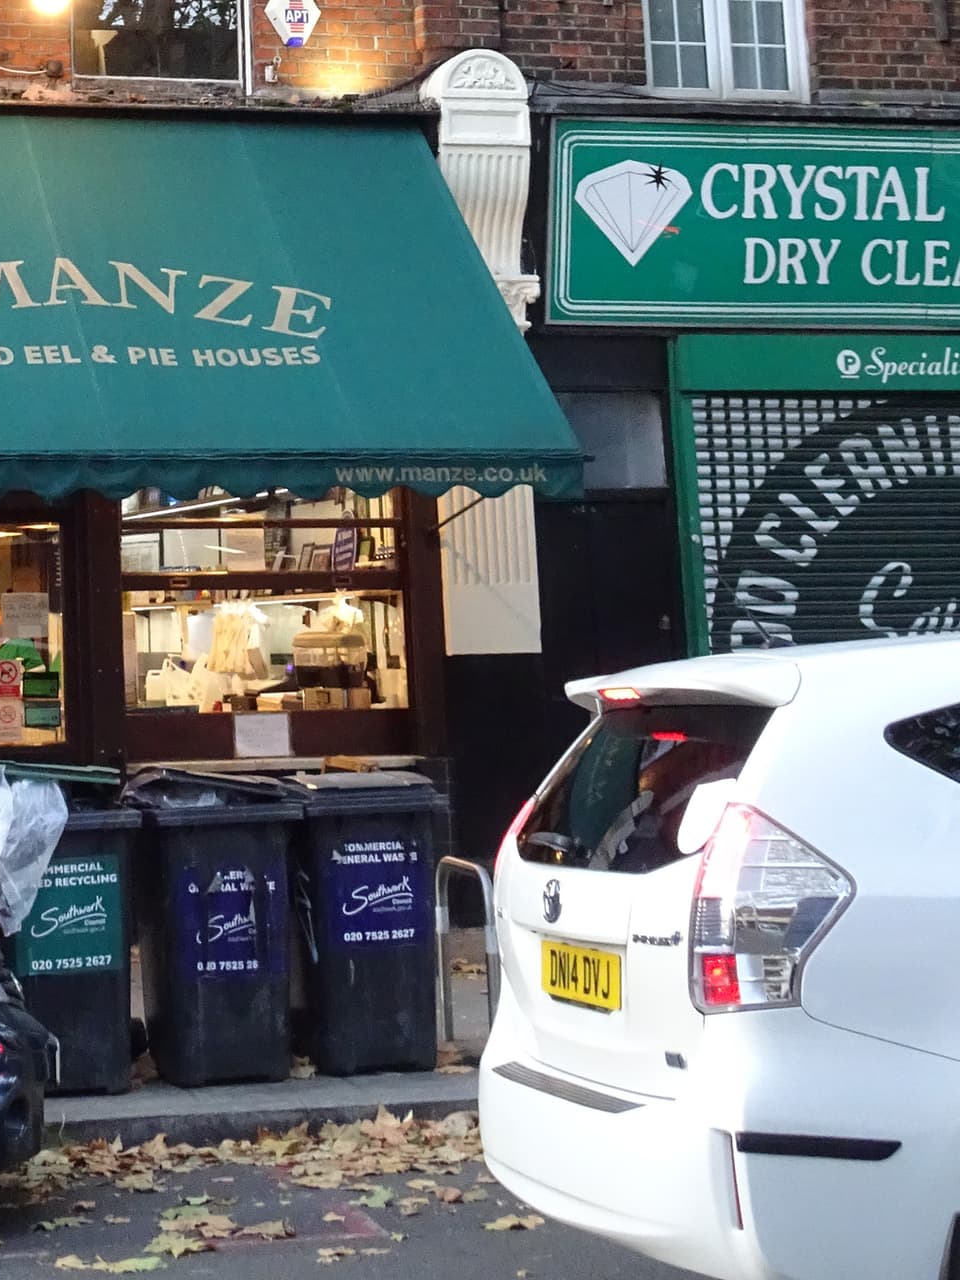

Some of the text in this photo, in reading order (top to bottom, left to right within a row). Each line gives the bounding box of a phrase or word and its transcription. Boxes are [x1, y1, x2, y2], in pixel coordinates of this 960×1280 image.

[286, 10, 309, 22] APT
[701, 163, 946, 222] CRYSTAL
[743, 238, 842, 285] DRY
[26, 345, 87, 363] EEL
[91, 344, 117, 364] &
[129, 347, 178, 366] PIE
[192, 345, 321, 367] HOUSES
[335, 463, 548, 483] www.manze.co.uk
[55, 873, 117, 887] RECYCLING
[344, 928, 415, 941] 020 7525 2627
[32, 955, 112, 970] 020 7525 2627
[219, 961, 244, 970] 7525
[550, 949, 610, 999] DN14 DVJ
